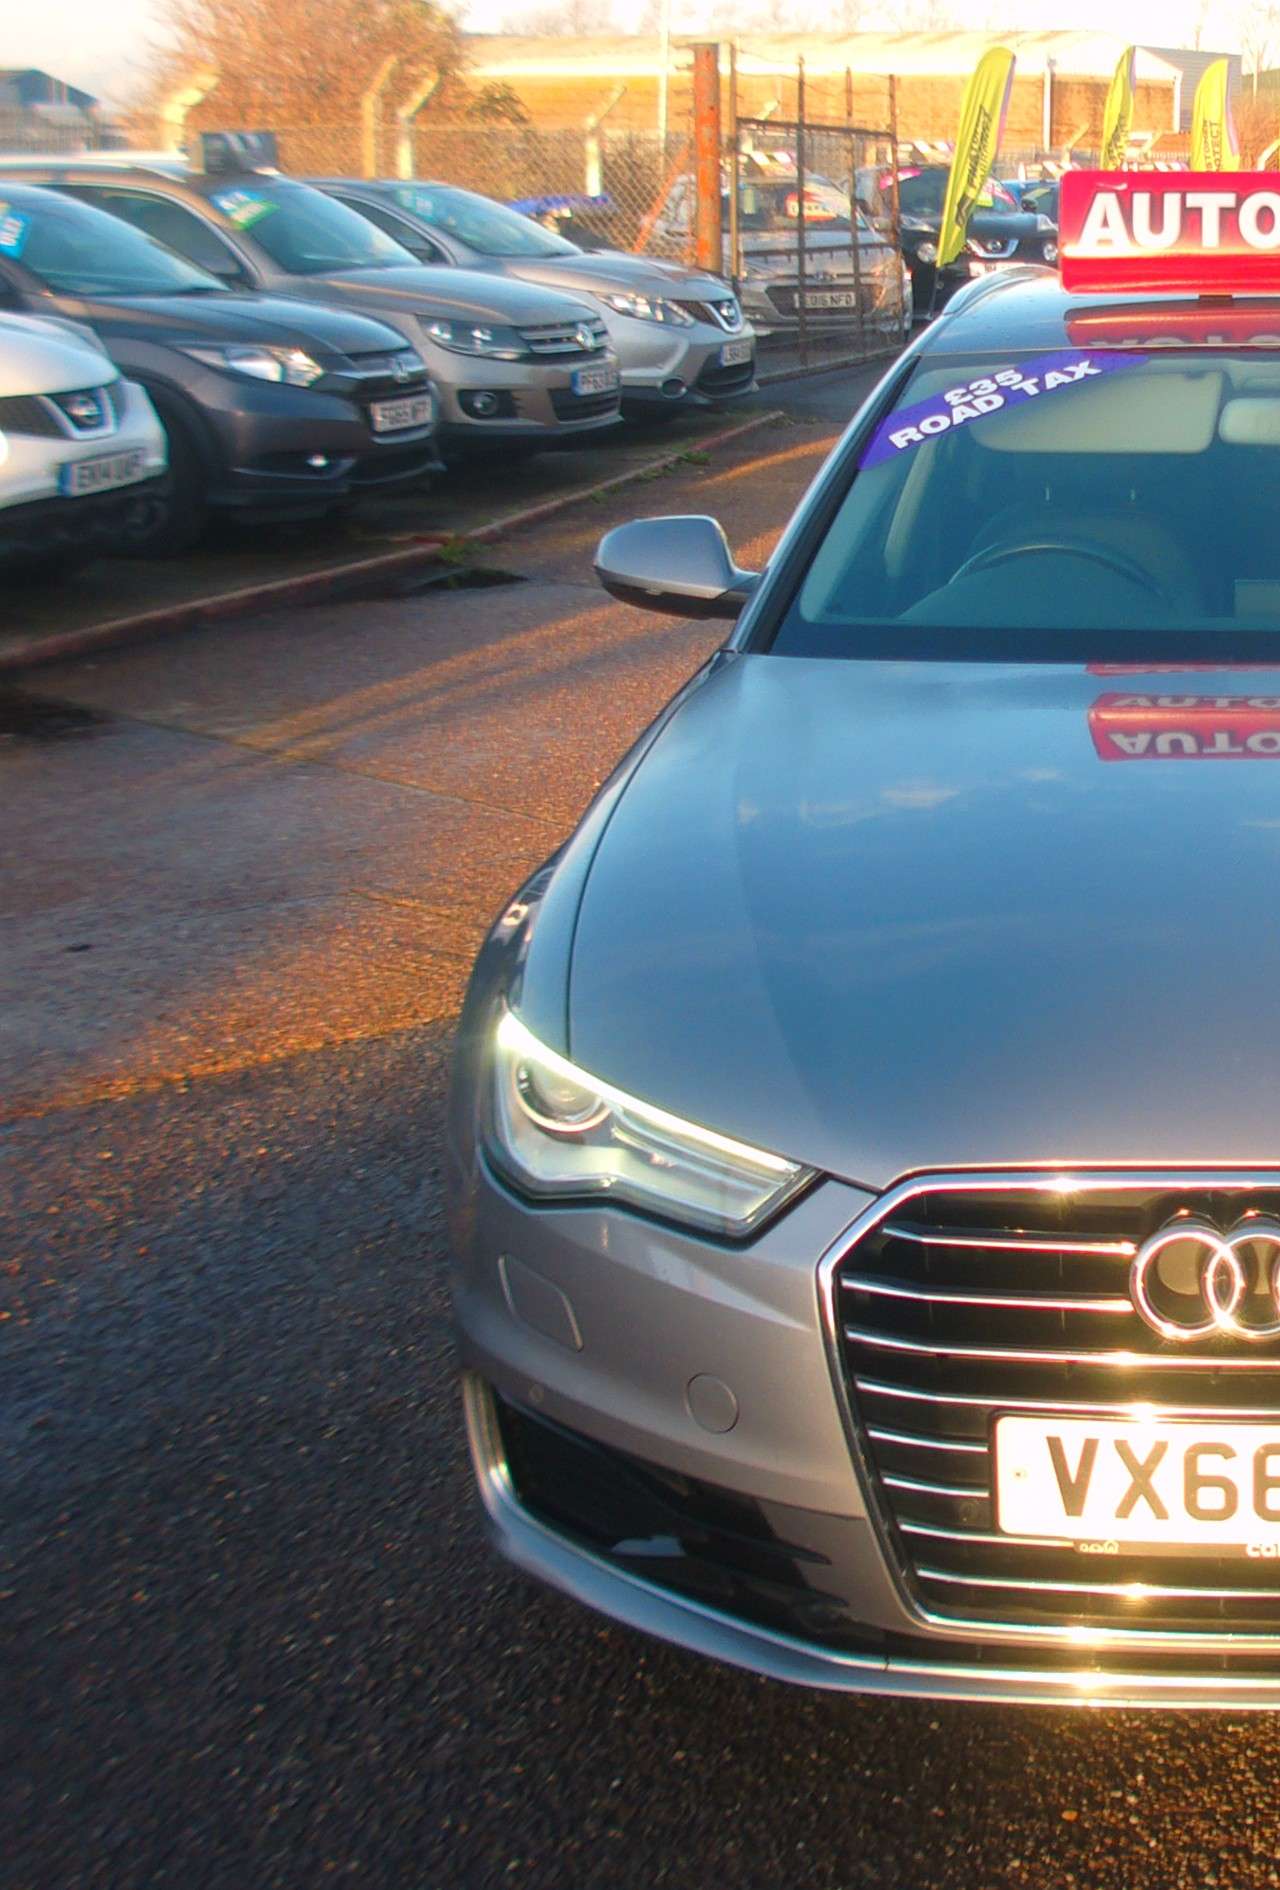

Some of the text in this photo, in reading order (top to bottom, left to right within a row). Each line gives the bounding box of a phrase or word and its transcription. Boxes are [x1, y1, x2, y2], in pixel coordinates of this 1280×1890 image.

[889, 360, 1103, 450] ROAD TAX
[944, 369, 1025, 407] £35
